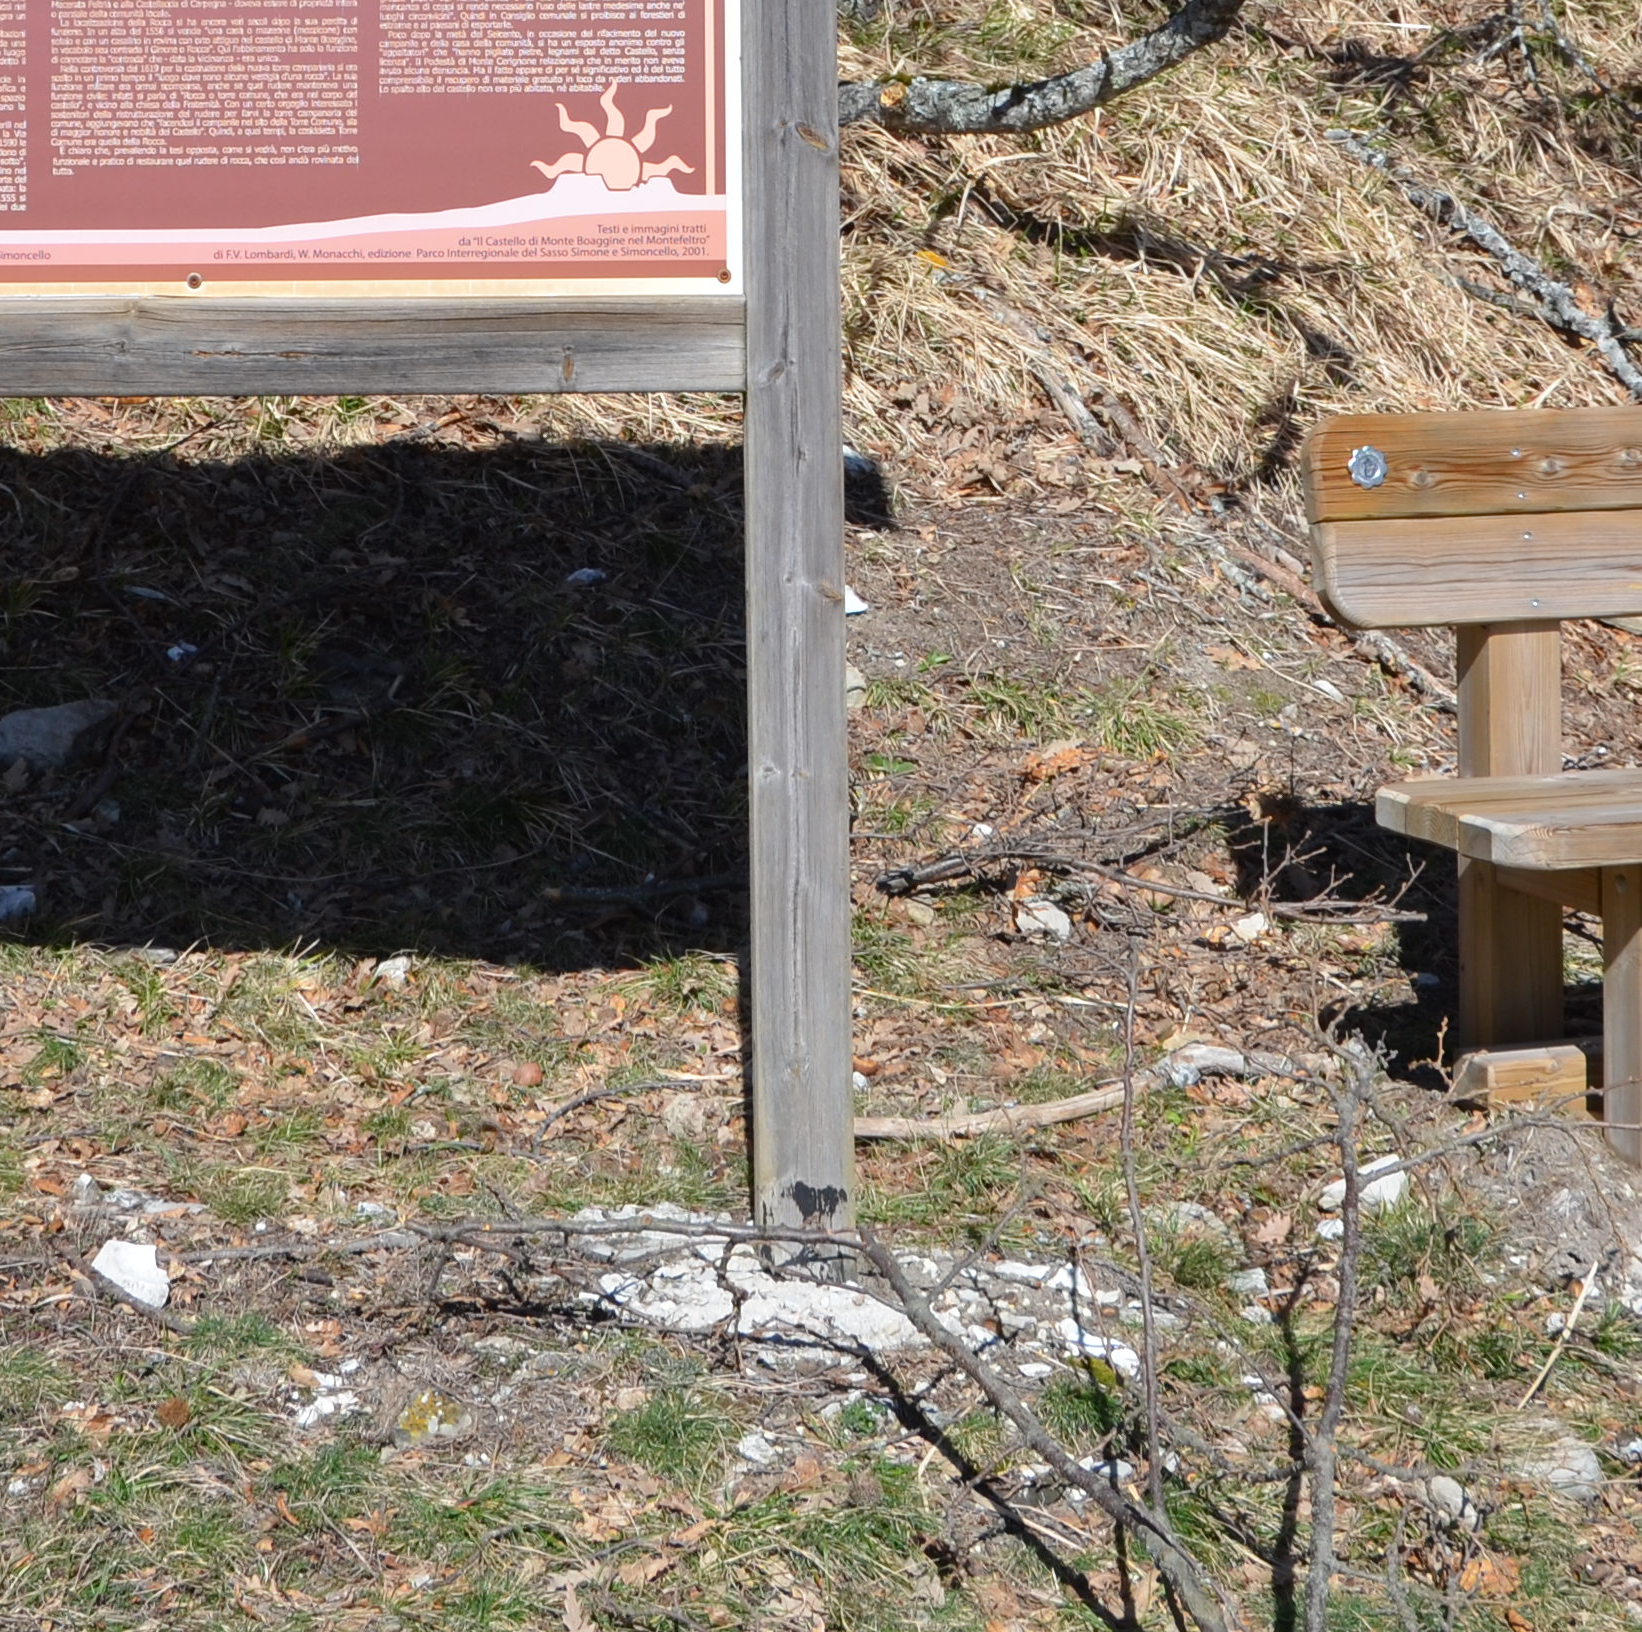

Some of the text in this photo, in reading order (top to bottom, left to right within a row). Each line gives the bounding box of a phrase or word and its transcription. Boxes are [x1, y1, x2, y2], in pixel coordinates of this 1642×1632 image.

[596, 223, 706, 236] Testi immagini tratti
[485, 234, 710, 247] Castello Monte Boaggine nel Montefeltro"
[225, 247, 709, 260] F.V. Lombardi, Monacchi, edizione Parco Interregionale del Sasso Simone Simoncello, 2001.
